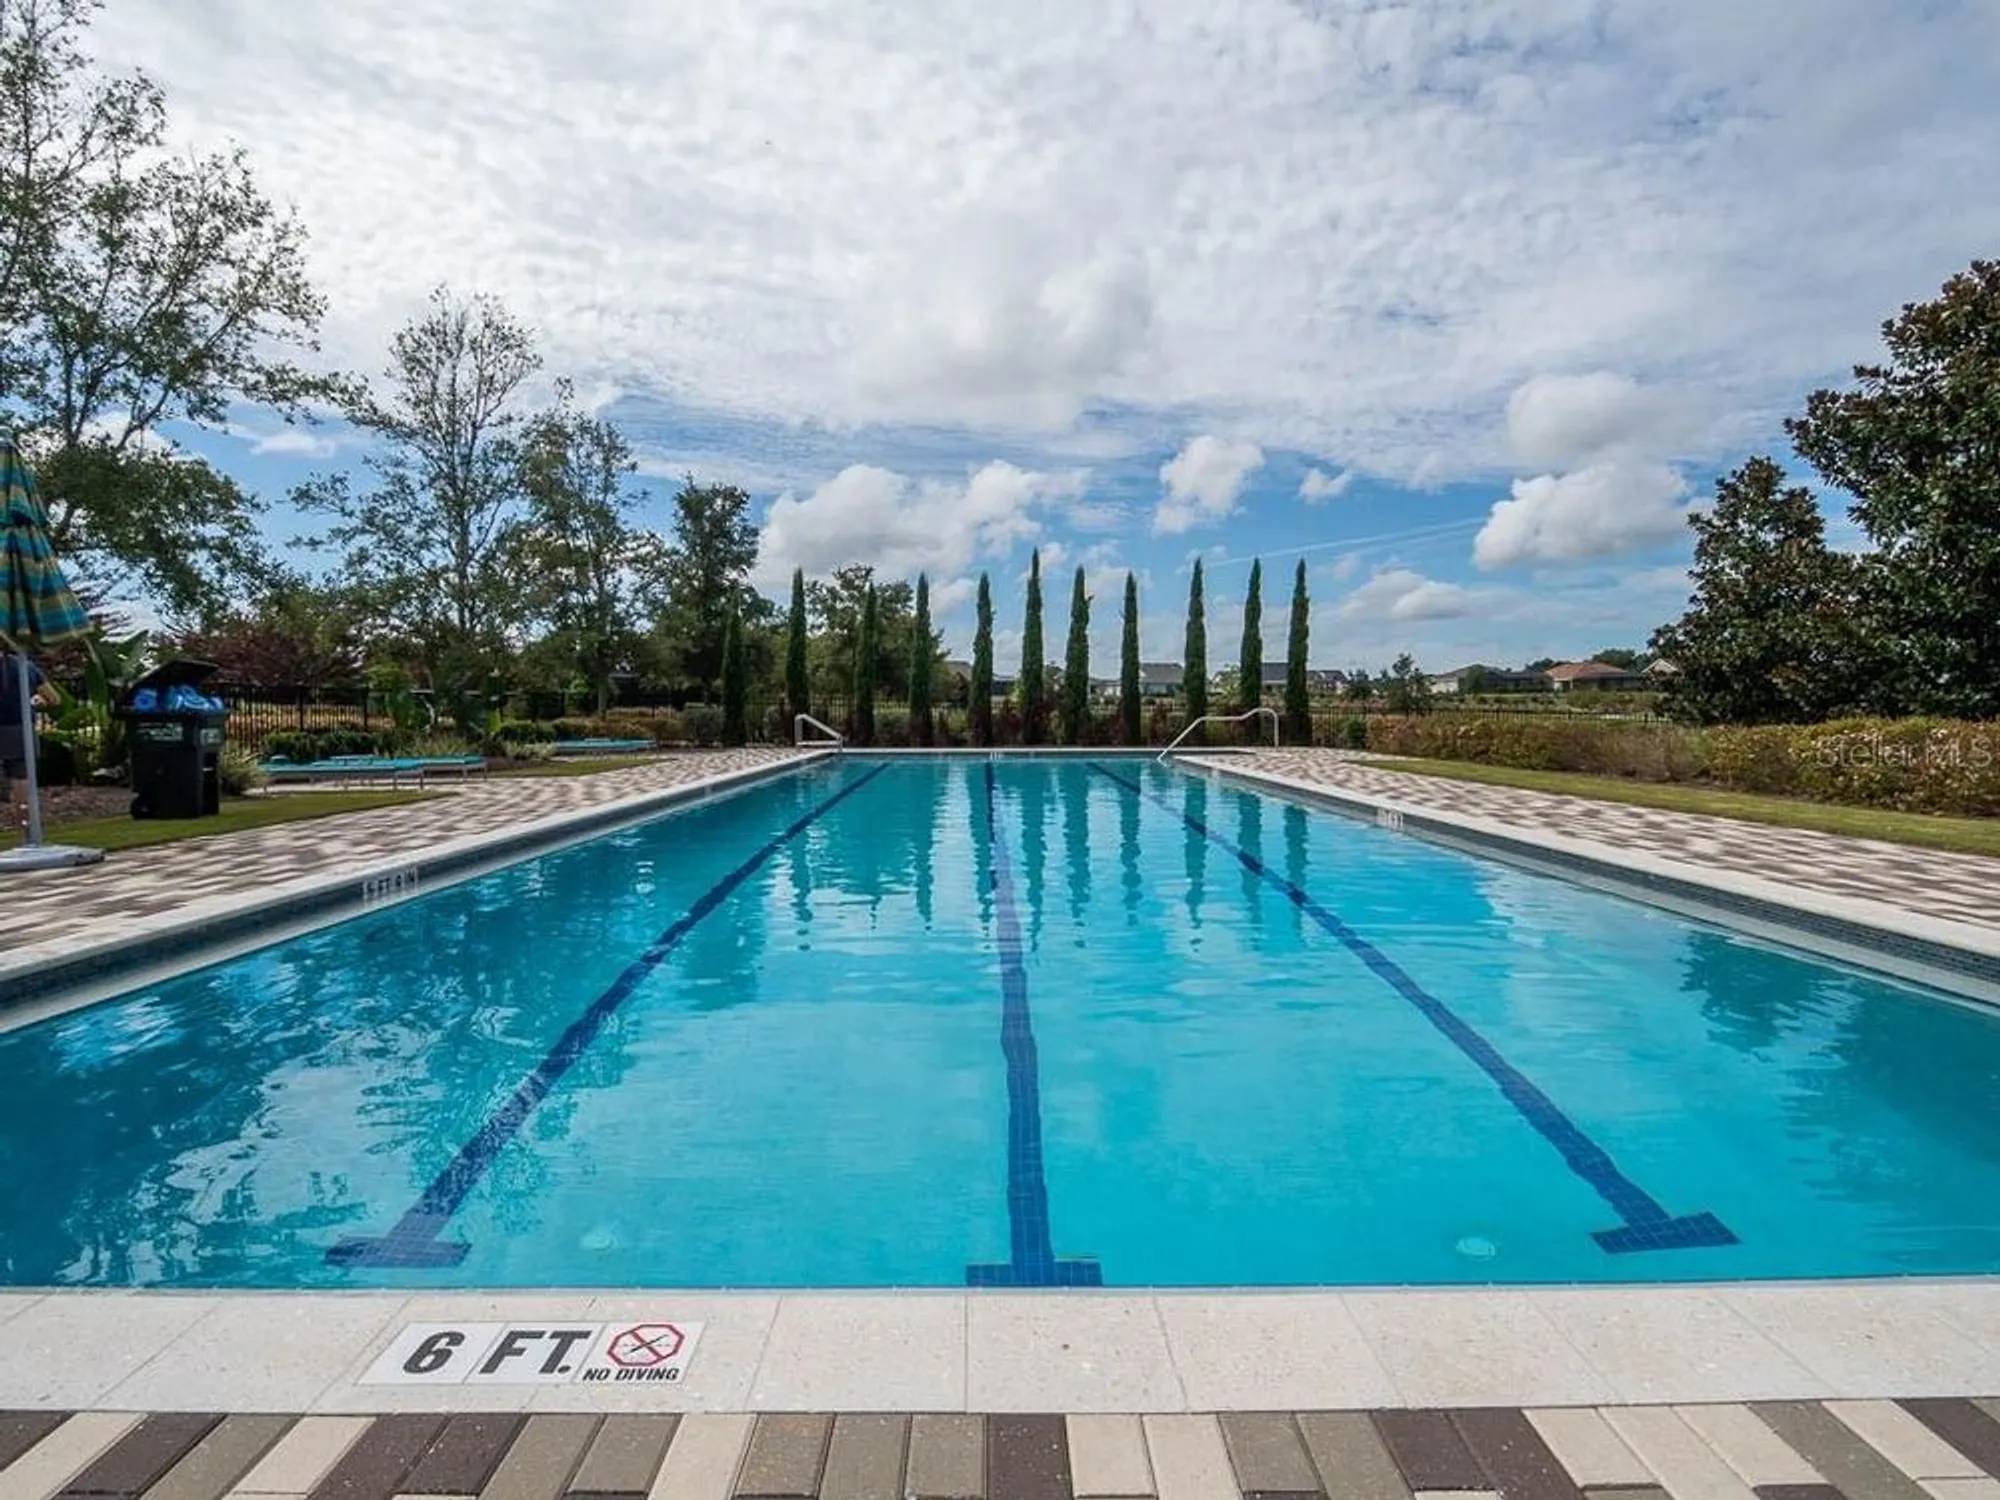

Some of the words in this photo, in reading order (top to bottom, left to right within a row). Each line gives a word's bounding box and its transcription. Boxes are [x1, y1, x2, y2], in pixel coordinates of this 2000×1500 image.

[402, 1330, 466, 1374] 6
[478, 1330, 593, 1374] FT.
[582, 1367, 611, 1382] NO
[613, 1367, 680, 1382] DIVING
